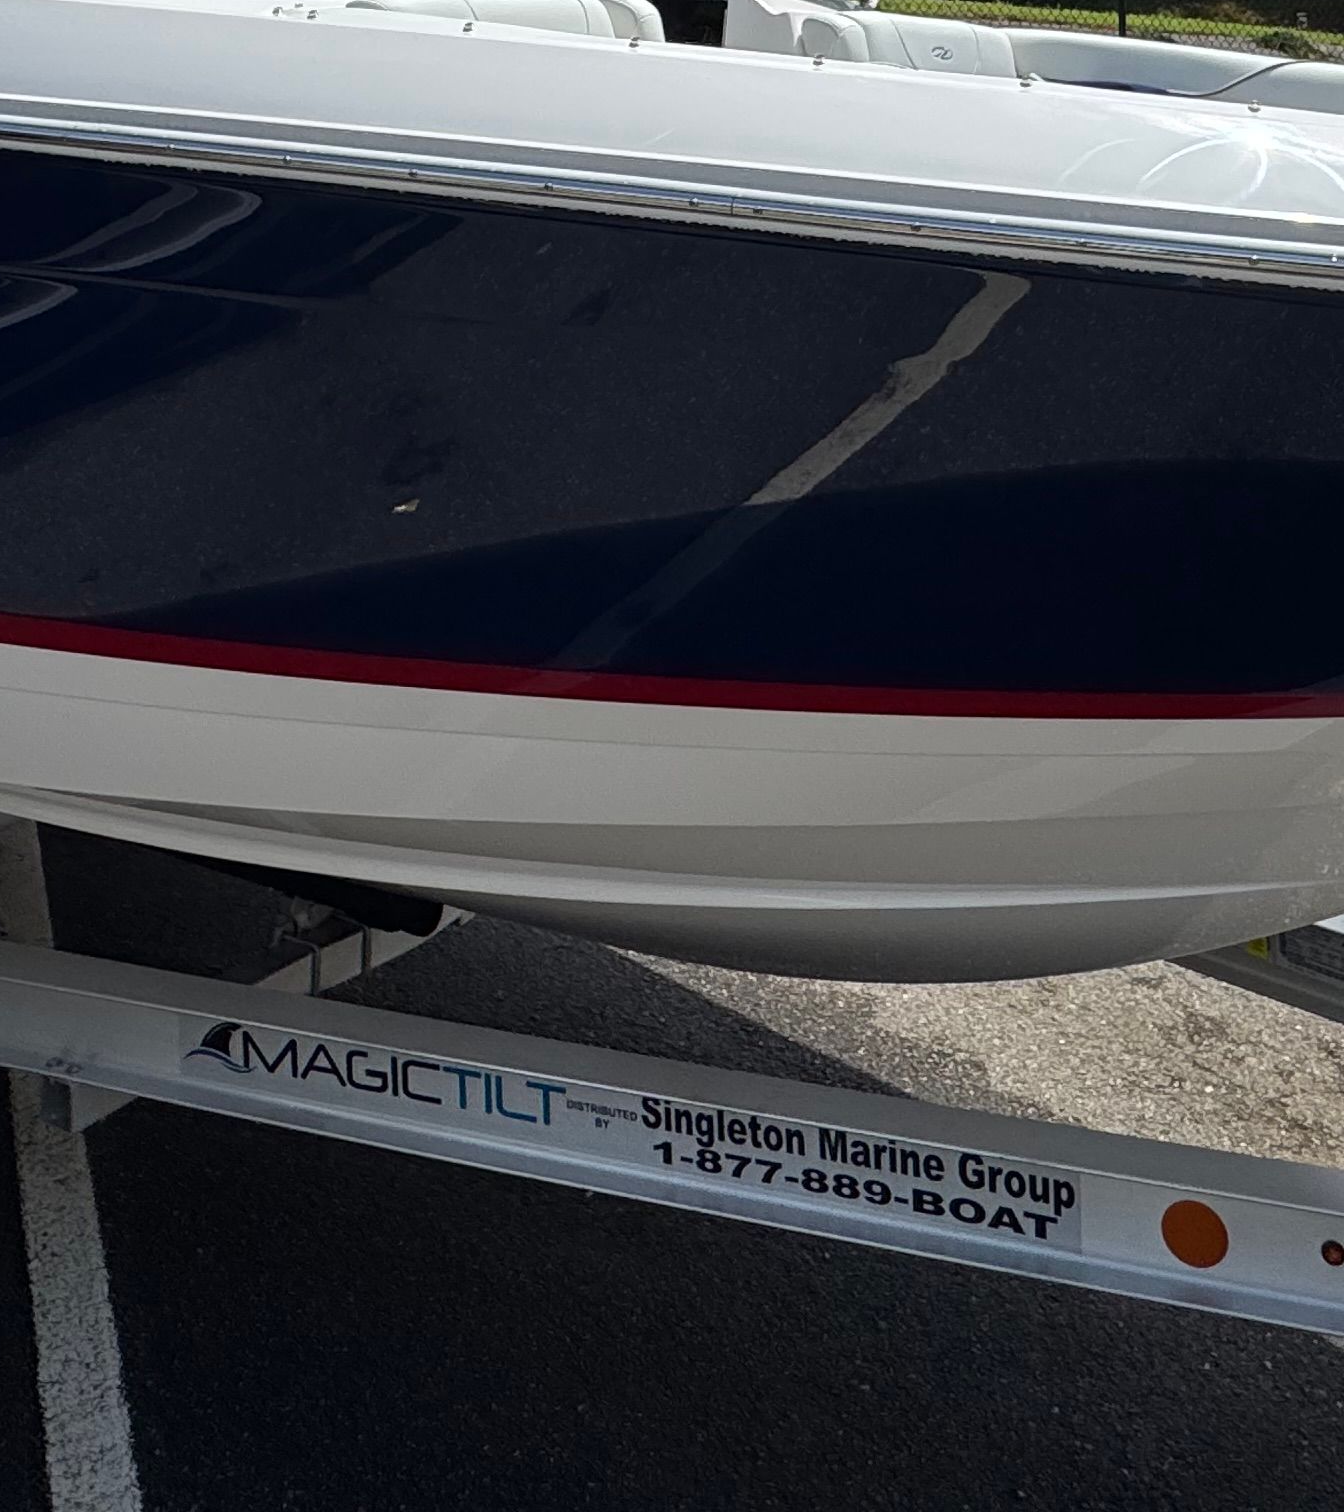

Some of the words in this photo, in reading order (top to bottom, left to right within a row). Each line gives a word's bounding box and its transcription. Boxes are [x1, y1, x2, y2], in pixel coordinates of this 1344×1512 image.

[566, 1099, 638, 1122] DISTRIBUTED
[594, 1118, 610, 1130] BY
[641, 1096, 806, 1157] Singleton
[819, 1127, 945, 1182] Marine
[958, 1152, 1076, 1217] Group
[653, 1141, 1058, 1240] 1-877-889-BOAT
